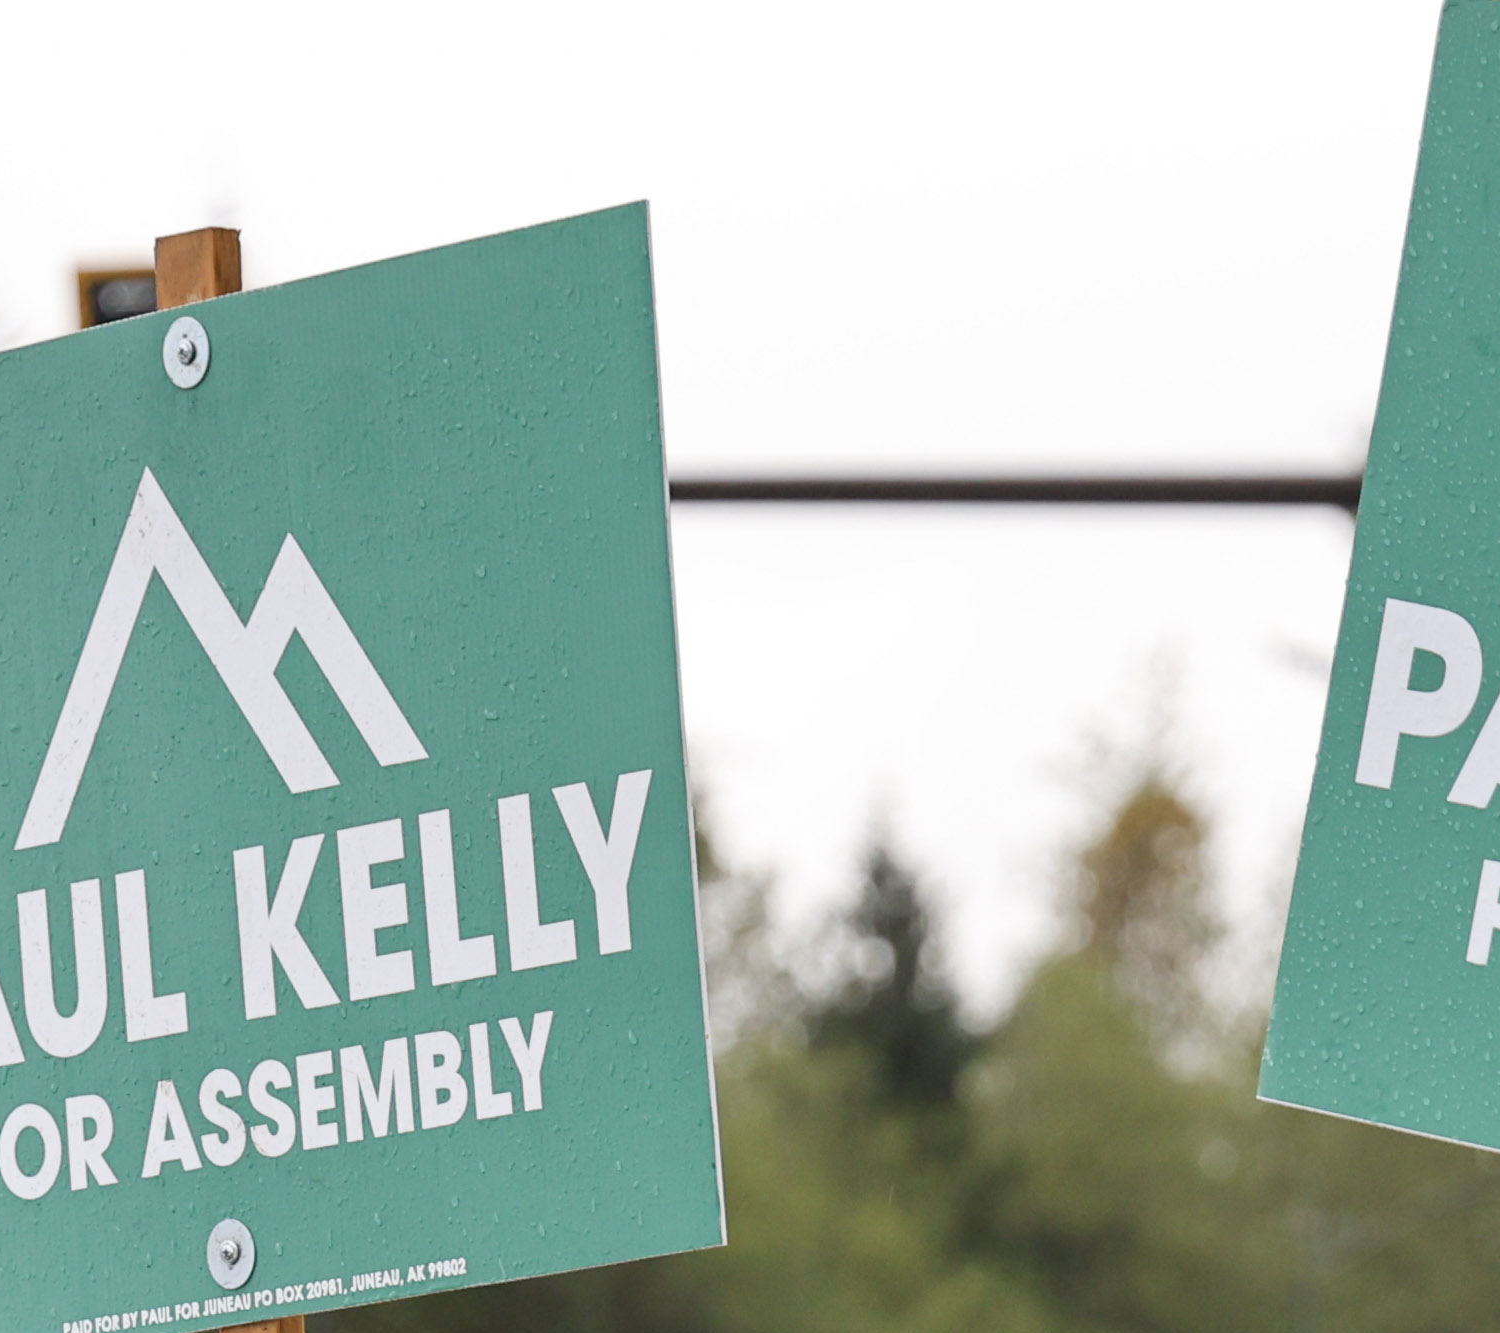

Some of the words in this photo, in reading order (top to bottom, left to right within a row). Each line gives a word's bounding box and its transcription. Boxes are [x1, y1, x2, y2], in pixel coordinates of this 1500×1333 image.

[233, 770, 652, 1020] KELLY
[142, 1011, 553, 1178] ASSEMBLY
[94, 1314, 121, 1333] FOR
[121, 1311, 139, 1330] BY
[140, 1306, 174, 1327] PAUL
[174, 1301, 201, 1321] FOR
[202, 1292, 252, 1317] JUNEAU
[253, 1289, 274, 1308] PO
[275, 1284, 305, 1305] BOX
[305, 1277, 348, 1300] 20981,
[349, 1268, 405, 1293] JUNEAU,
[406, 1264, 427, 1283] AK
[427, 1257, 467, 1280] 99802
